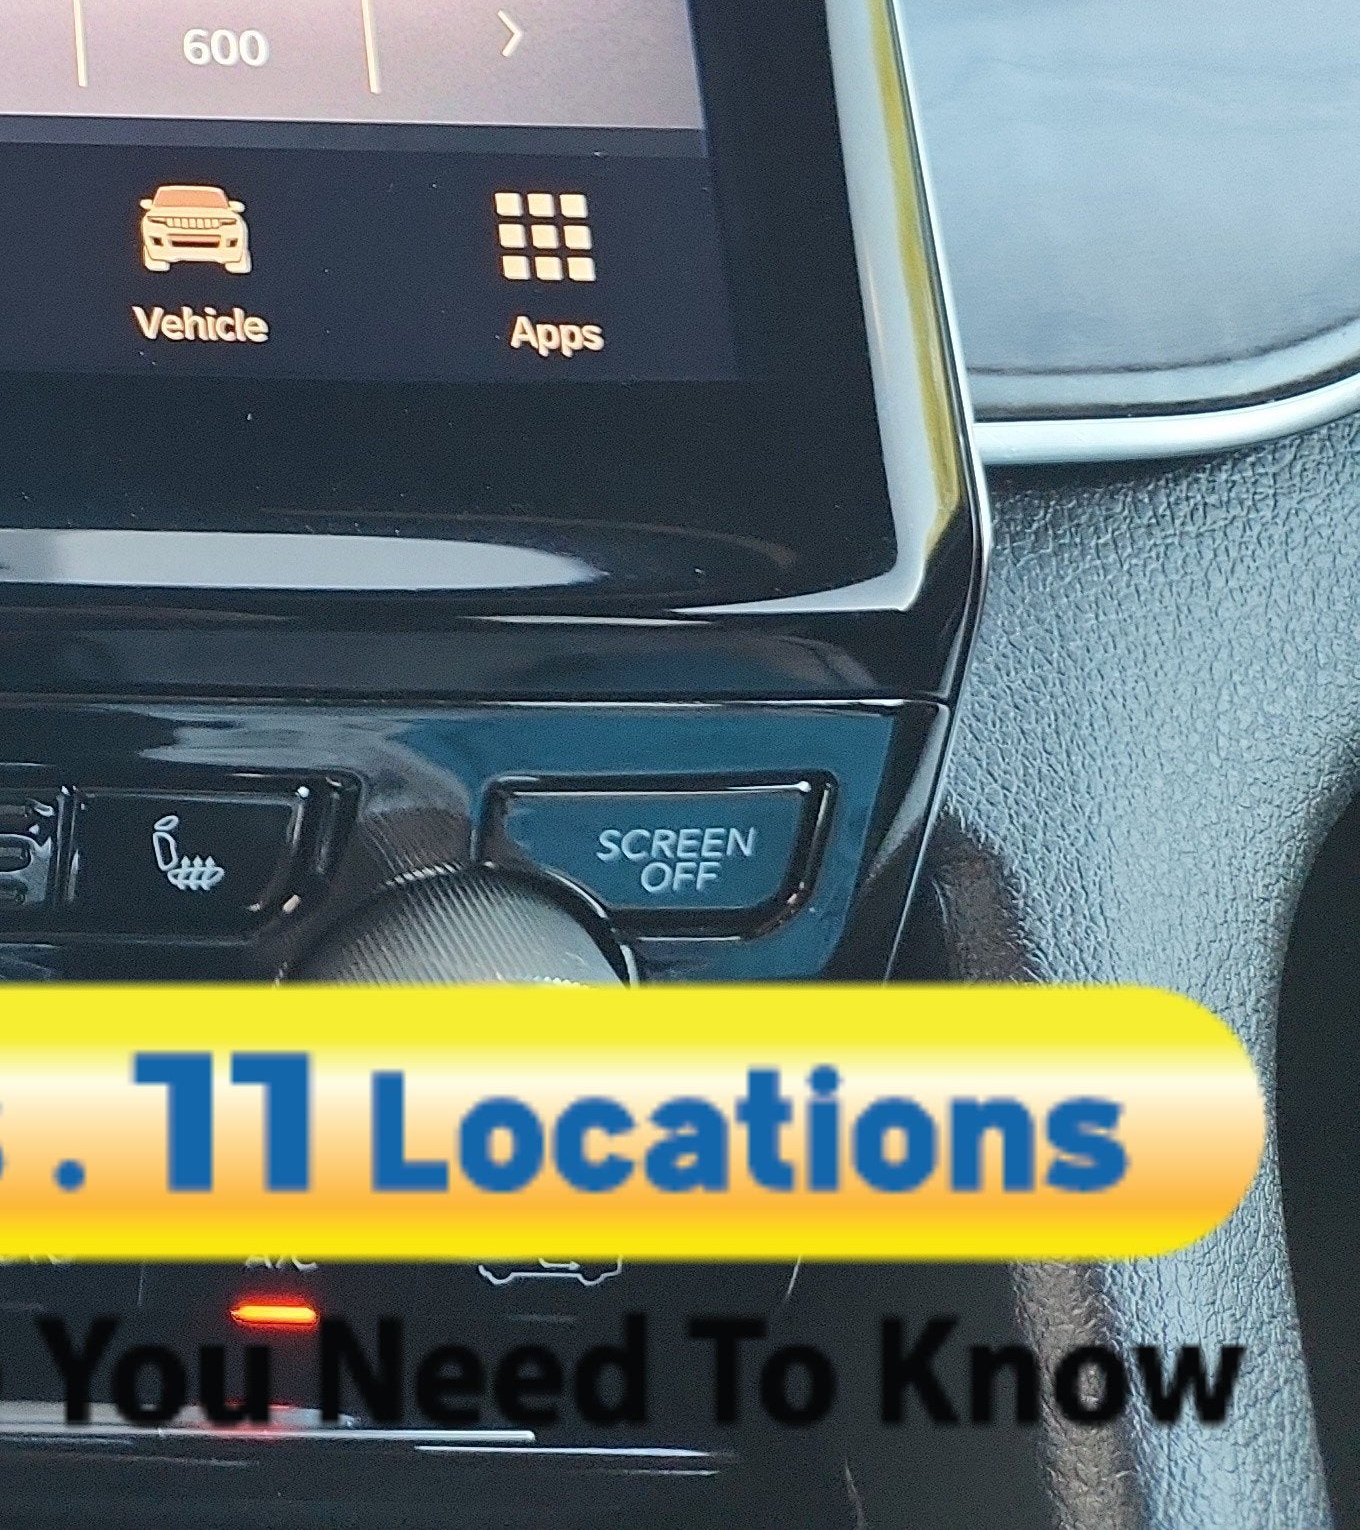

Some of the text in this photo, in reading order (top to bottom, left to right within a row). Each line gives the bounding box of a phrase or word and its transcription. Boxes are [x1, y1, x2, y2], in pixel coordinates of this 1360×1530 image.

[183, 29, 269, 67] 600
[132, 305, 269, 343] Vehicle
[510, 315, 605, 358] Apps
[595, 826, 756, 863] SCREEN
[640, 860, 722, 894] OFF
